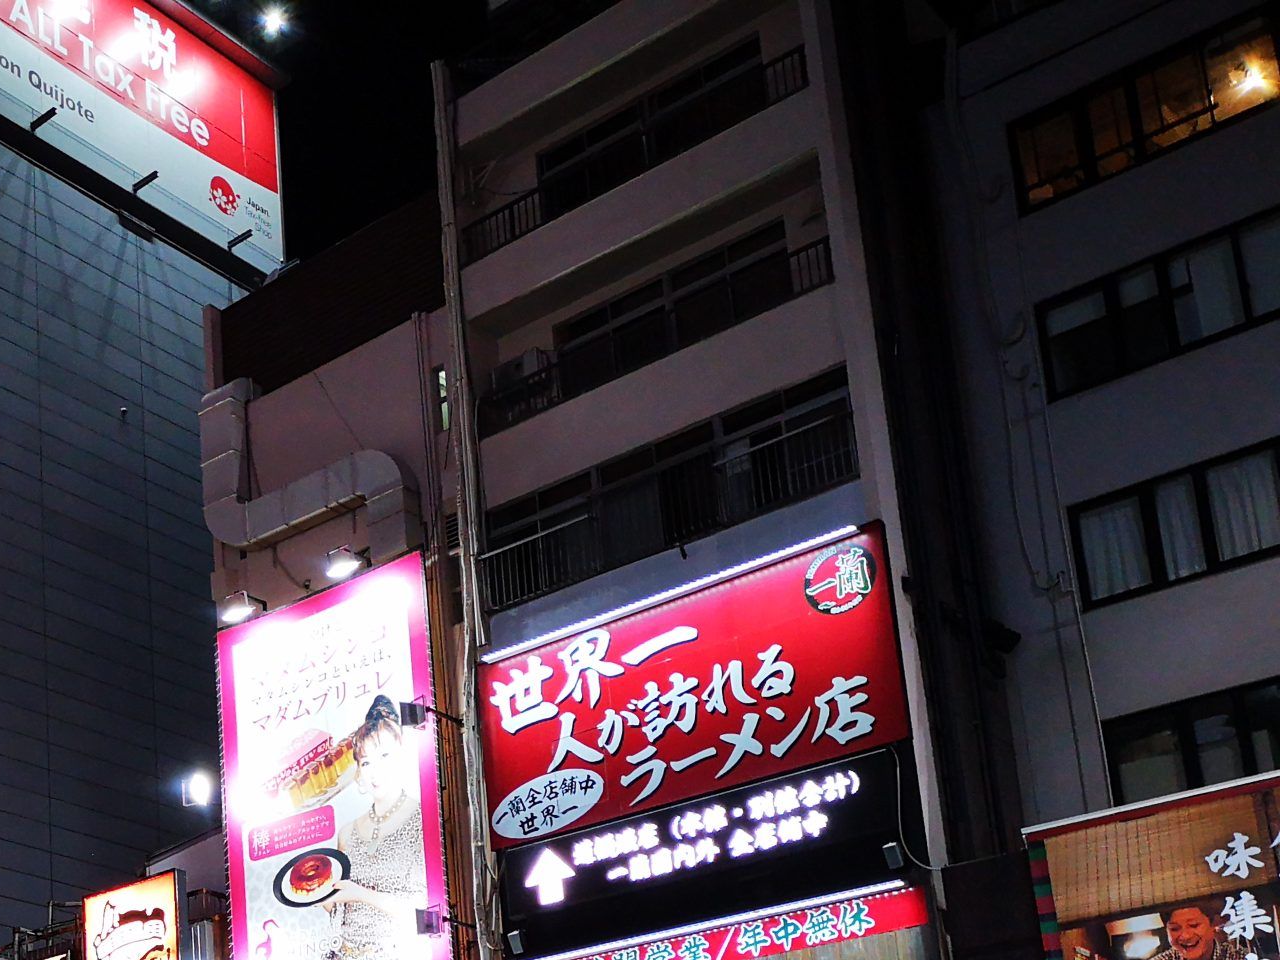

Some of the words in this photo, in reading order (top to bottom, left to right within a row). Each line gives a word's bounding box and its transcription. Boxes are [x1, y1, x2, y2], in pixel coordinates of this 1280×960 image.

[28, 69, 95, 124] Quijote
[77, 37, 135, 101] Tax
[144, 80, 211, 146] Free
[806, 548, 872, 598] 一蘭
[252, 671, 394, 732] マダムブリュレ
[489, 625, 699, 734] 世界一
[546, 643, 795, 774] 人が訪れる
[619, 675, 877, 806] ラーメン店
[519, 803, 580, 836] 世界一
